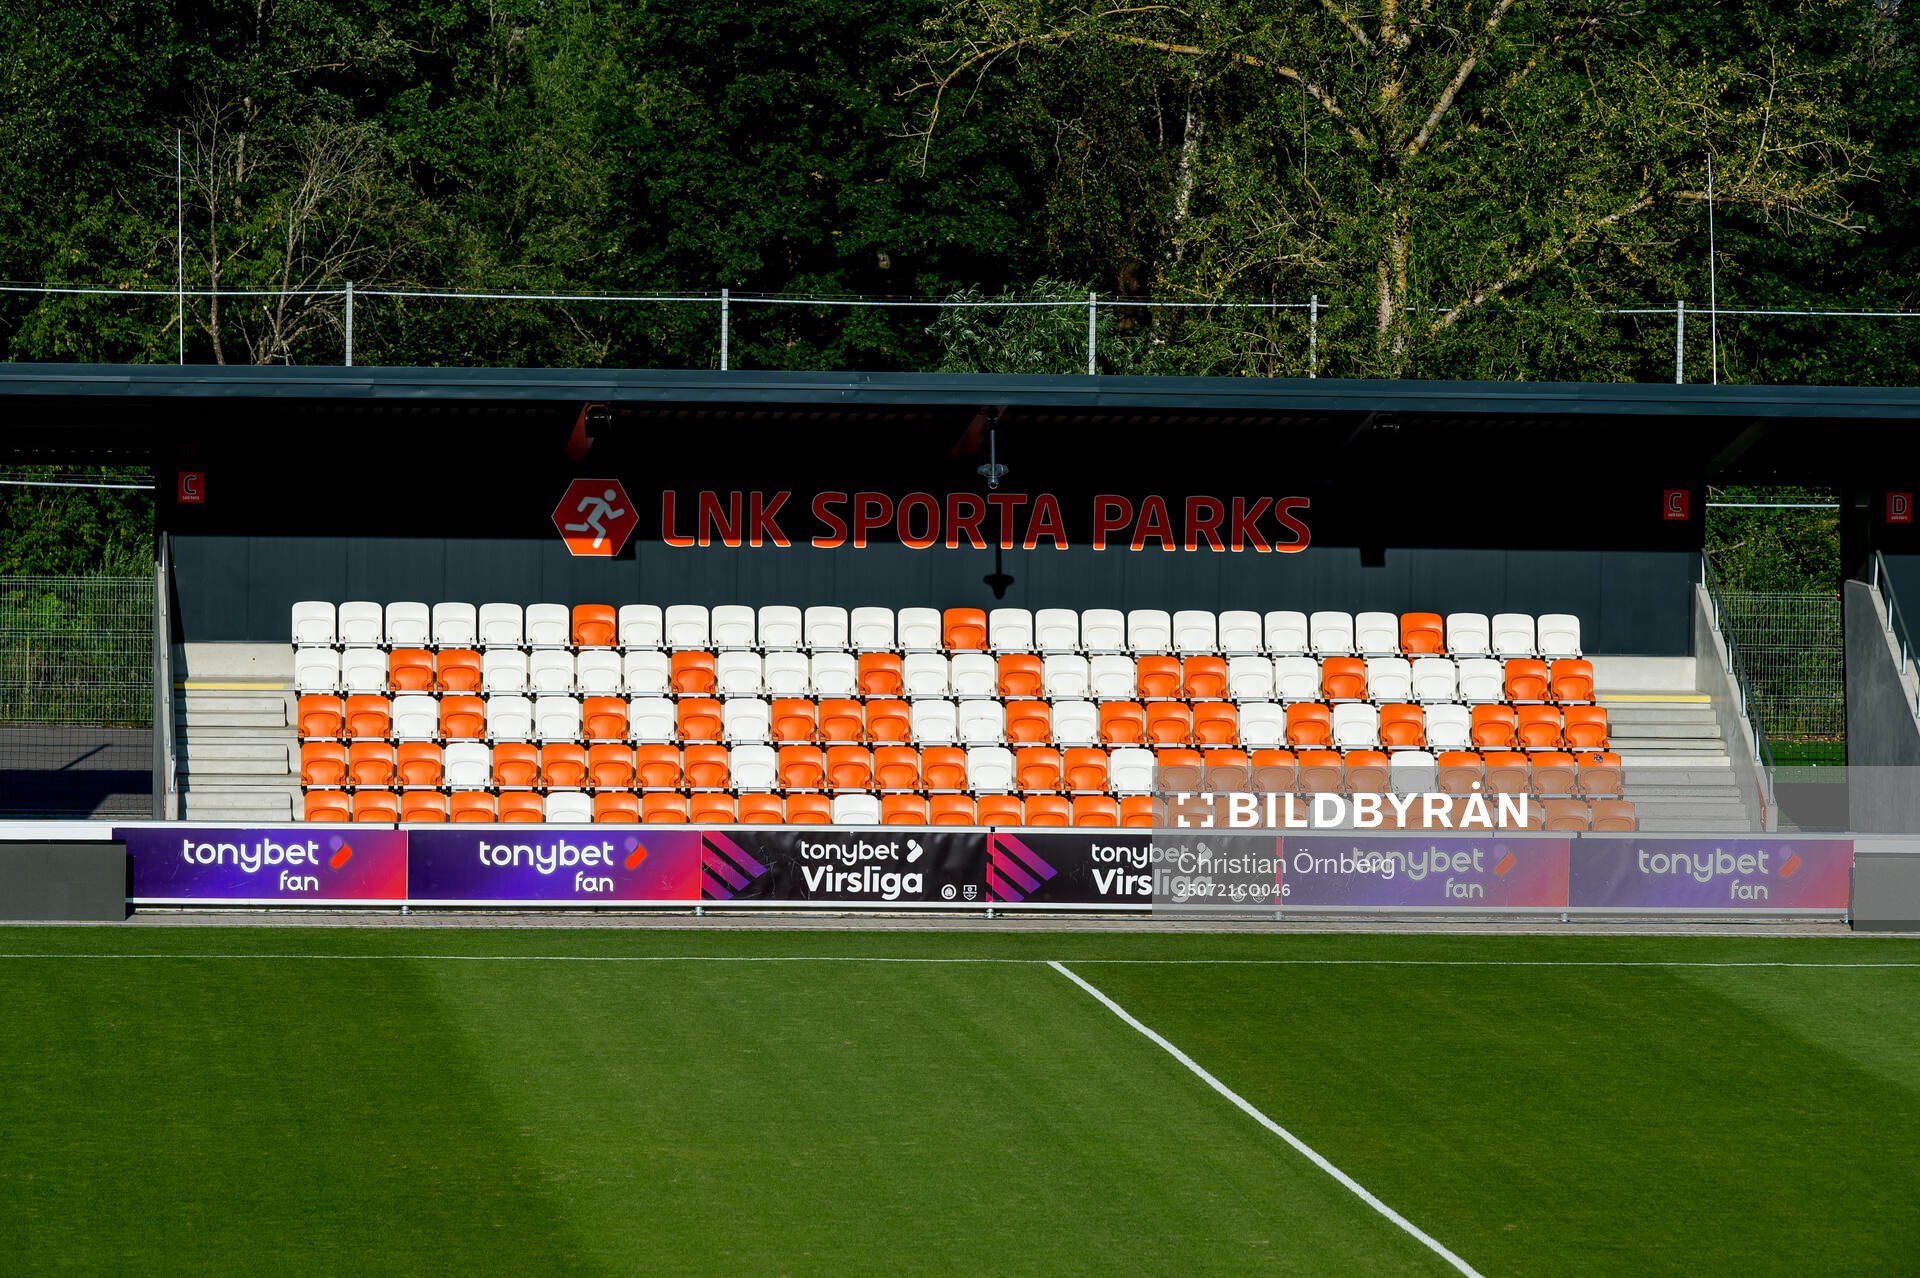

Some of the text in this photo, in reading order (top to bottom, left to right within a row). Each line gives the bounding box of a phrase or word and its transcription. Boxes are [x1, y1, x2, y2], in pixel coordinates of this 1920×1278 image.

[183, 475, 197, 495] C
[1668, 492, 1682, 512] C
[1892, 494, 1907, 515] D
[661, 490, 1311, 553] LNK SPORTA PARKS
[183, 838, 319, 873] tonybet
[479, 840, 614, 874] tonybet
[800, 840, 898, 867] tonybet
[1091, 843, 1189, 869] tonybet
[1352, 847, 1484, 881] tonybet
[1638, 848, 1769, 881] tonybet
[279, 871, 319, 892] fan
[574, 872, 614, 893] fan
[801, 865, 923, 901] Virslīga
[1445, 878, 1484, 900] fan
[1730, 878, 1769, 901] fan
